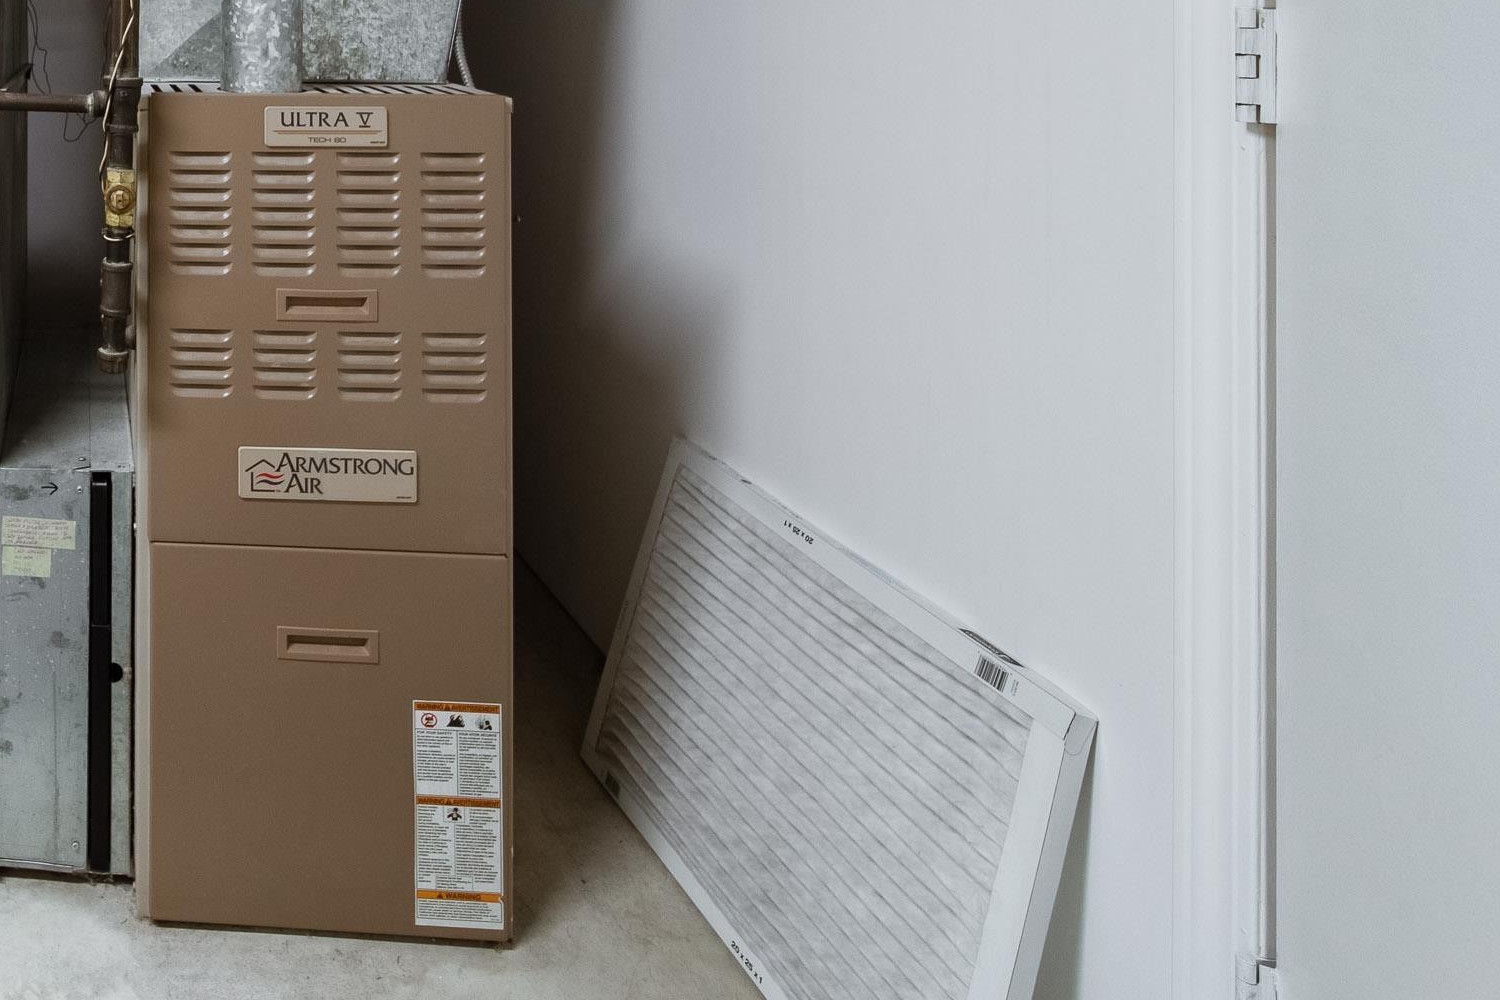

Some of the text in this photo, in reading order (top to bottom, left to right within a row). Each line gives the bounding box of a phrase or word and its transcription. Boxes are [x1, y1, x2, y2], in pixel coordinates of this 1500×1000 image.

[281, 112, 374, 128] ULTRA V
[275, 453, 414, 476] ARMSTRONG
[284, 474, 324, 494] AIR
[731, 940, 739, 953] 20
